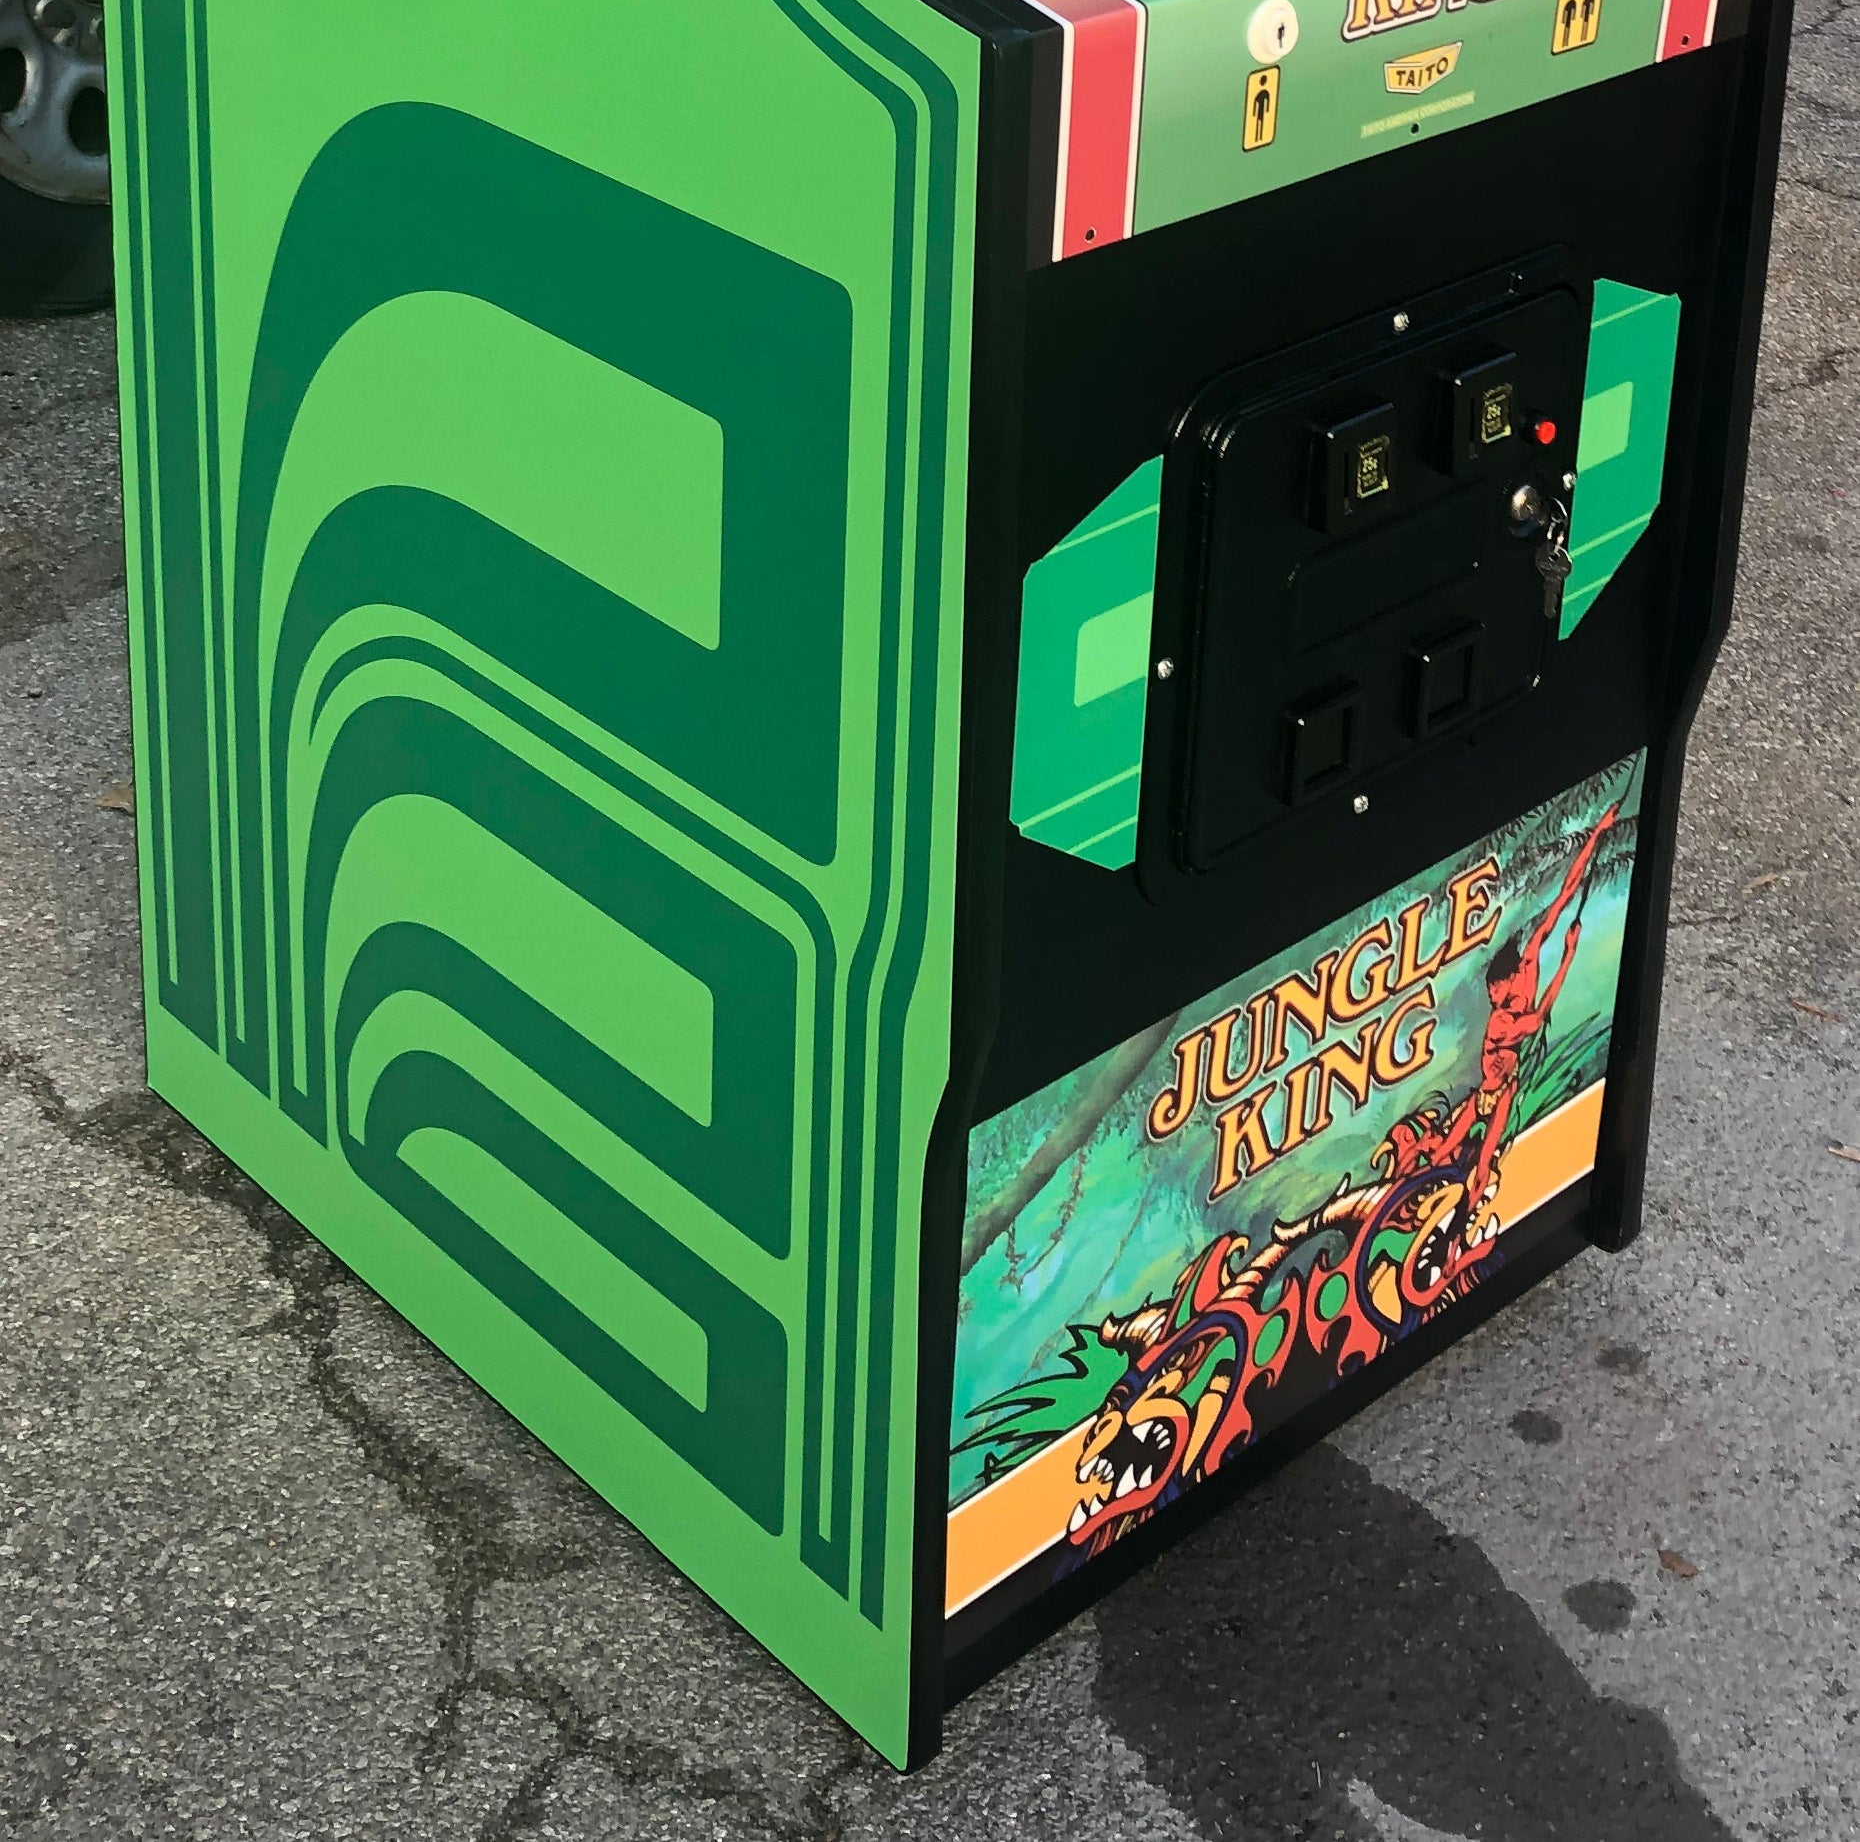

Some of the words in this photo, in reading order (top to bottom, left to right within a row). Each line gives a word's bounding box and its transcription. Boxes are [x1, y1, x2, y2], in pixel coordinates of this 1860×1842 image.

[1396, 57, 1449, 87] TAITO
[1149, 855, 1502, 1140] JUNGLE
[1208, 983, 1437, 1202] KING
